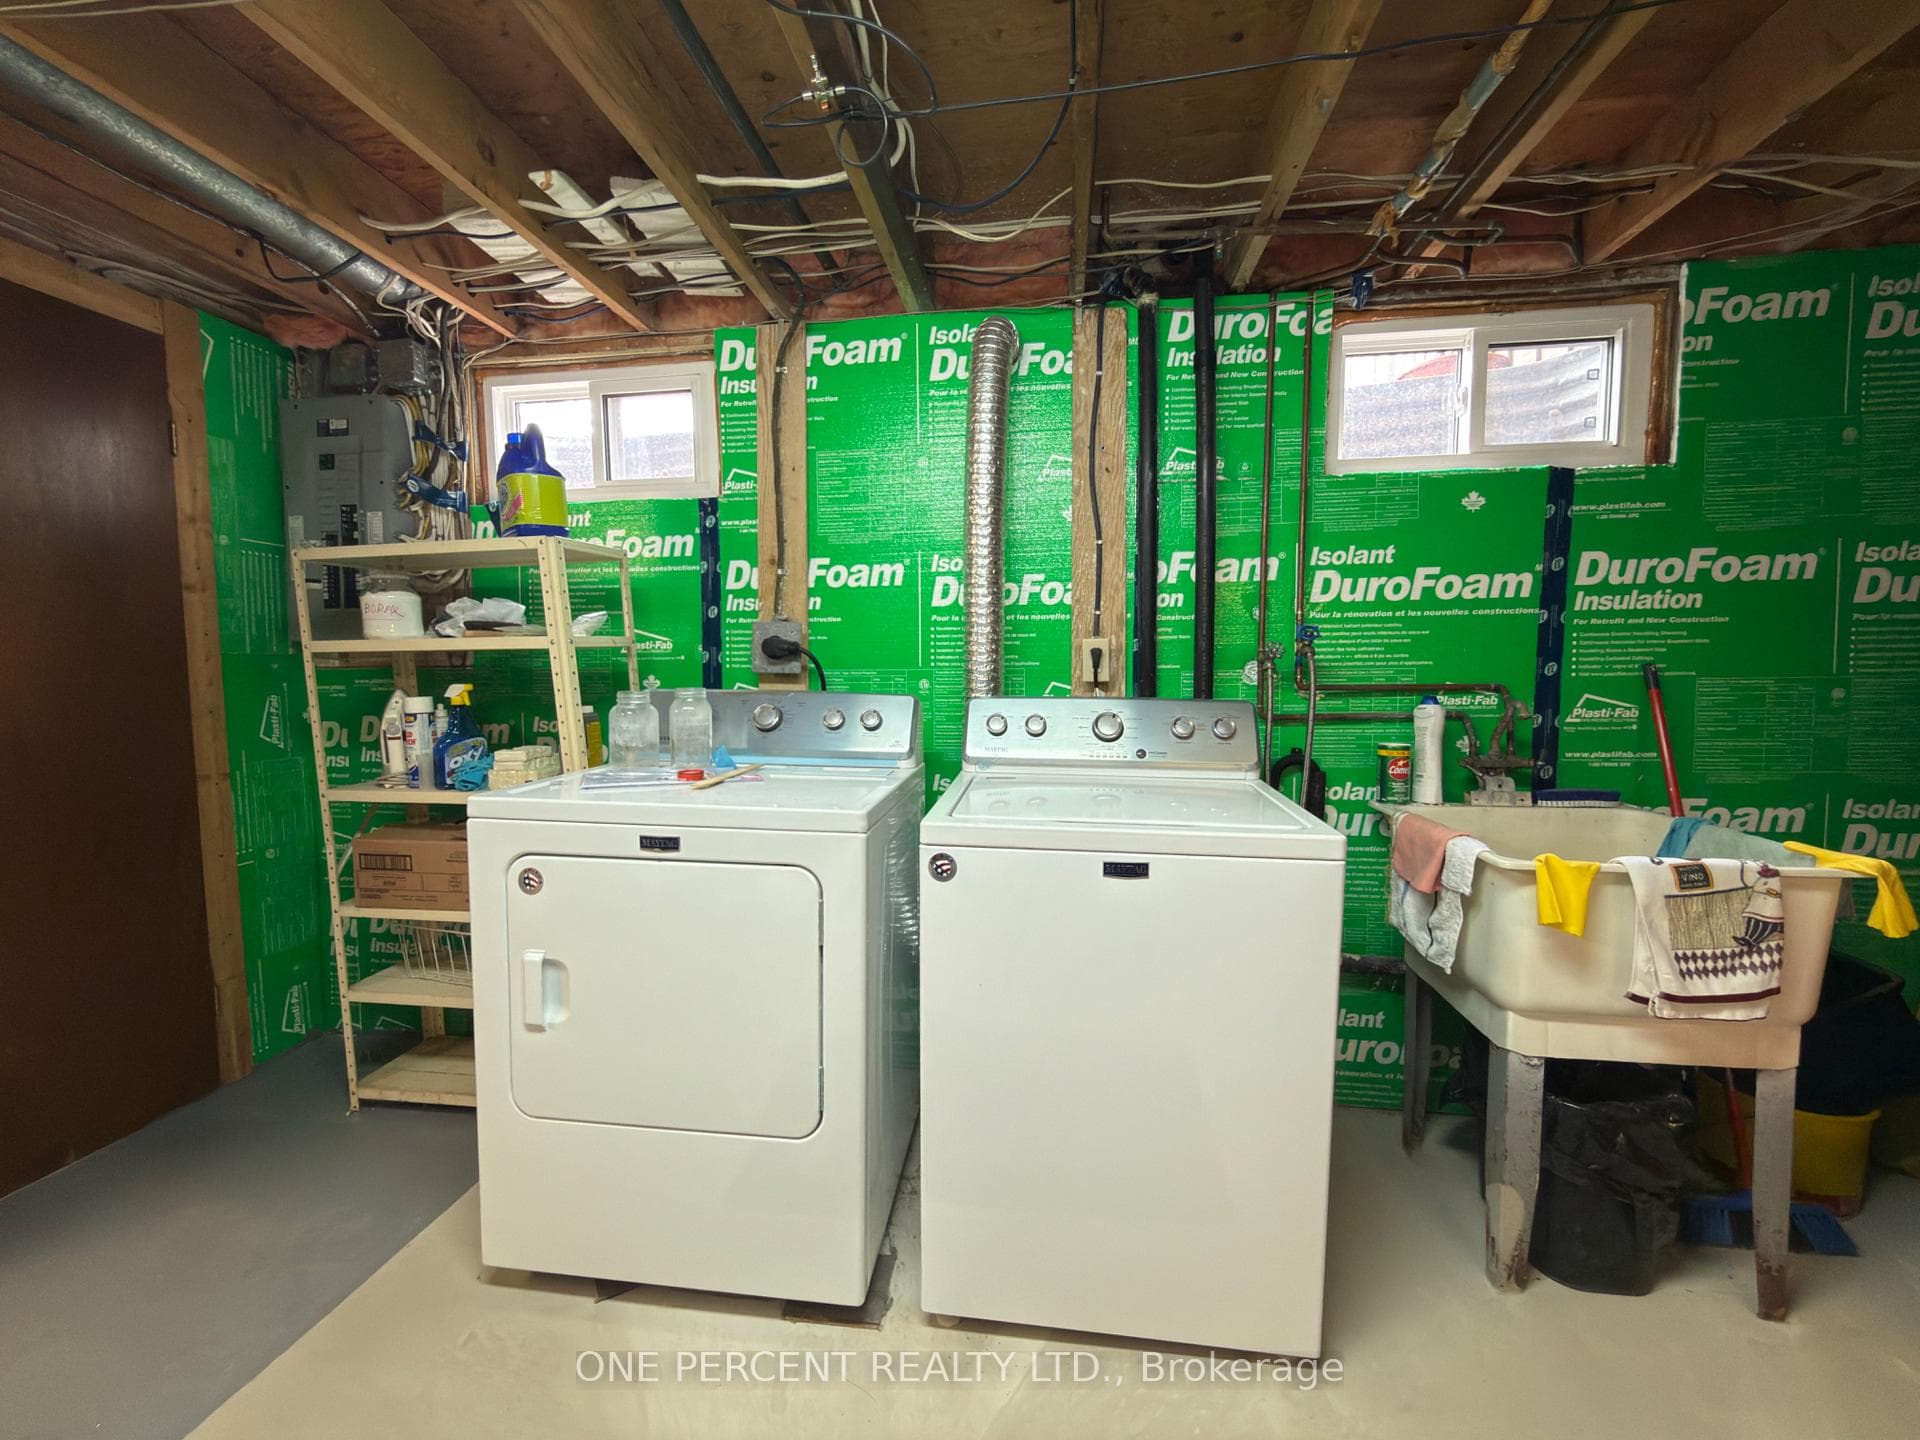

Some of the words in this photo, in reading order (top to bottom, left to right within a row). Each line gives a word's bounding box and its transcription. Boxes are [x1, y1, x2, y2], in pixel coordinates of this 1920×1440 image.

[1867, 273, 1920, 297] Isol
[929, 323, 977, 345] Isola
[1310, 545, 1396, 566] Isolant
[1855, 540, 1920, 563] Isola
[1574, 547, 1818, 586] DuroFoam
[1309, 566, 1533, 603] DuroFoam
[1573, 589, 1703, 611] Insulation
[1309, 610, 1331, 619] Pour
[1423, 608, 1470, 616] nouvelles
[1472, 607, 1540, 615] constructions
[1842, 798, 1920, 819] Isolan
